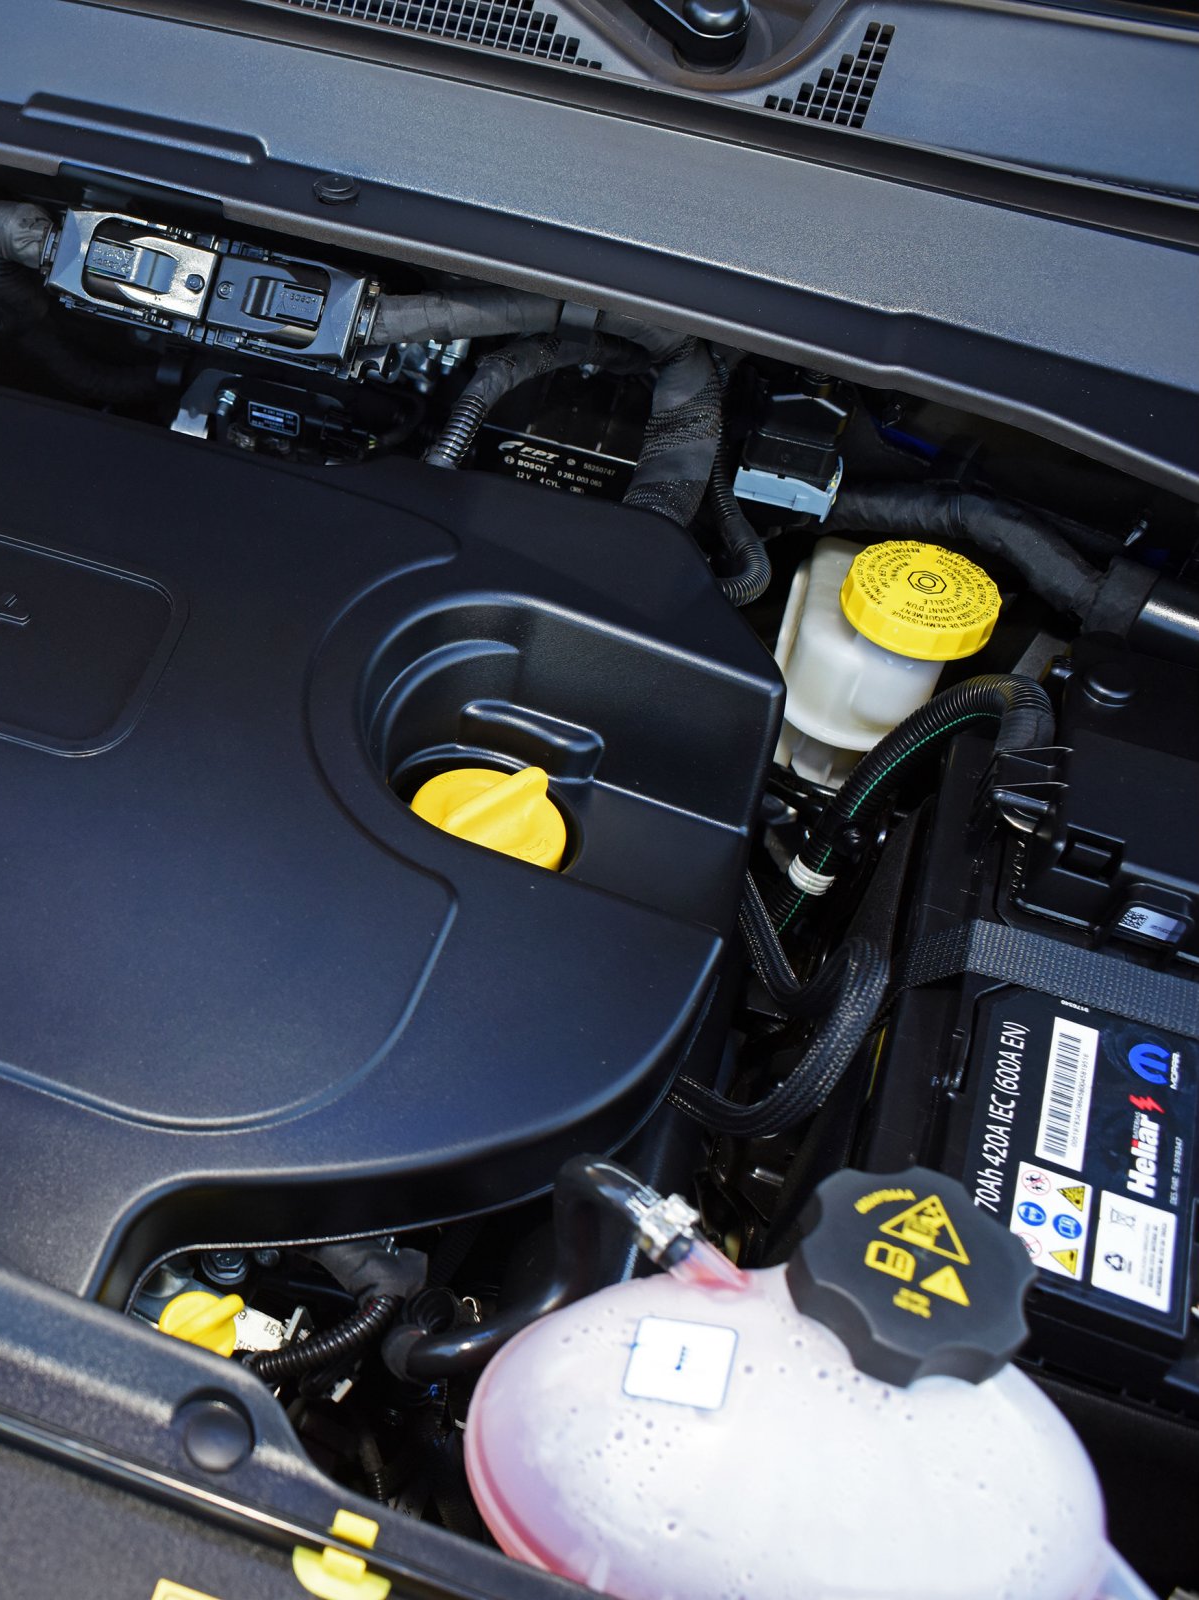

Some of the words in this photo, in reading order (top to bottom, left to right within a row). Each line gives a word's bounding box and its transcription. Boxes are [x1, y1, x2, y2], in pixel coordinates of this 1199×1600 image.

[520, 447, 560, 460] FPT
[516, 471, 524, 479] 12
[517, 460, 547, 472] BOSCH
[563, 472, 575, 481] 281
[936, 546, 953, 554] MISE
[939, 554, 963, 567] AVANT
[901, 608, 954, 621] UNIQUEMENT
[906, 601, 924, 611] D'UN
[1000, 1021, 1031, 1051] EN)
[992, 1050, 1023, 1096] (600A
[988, 1093, 1016, 1124] IEC
[982, 1123, 1011, 1164] 420A
[1127, 1112, 1161, 1199] Heliar
[974, 1169, 1004, 1213] 70Ah
